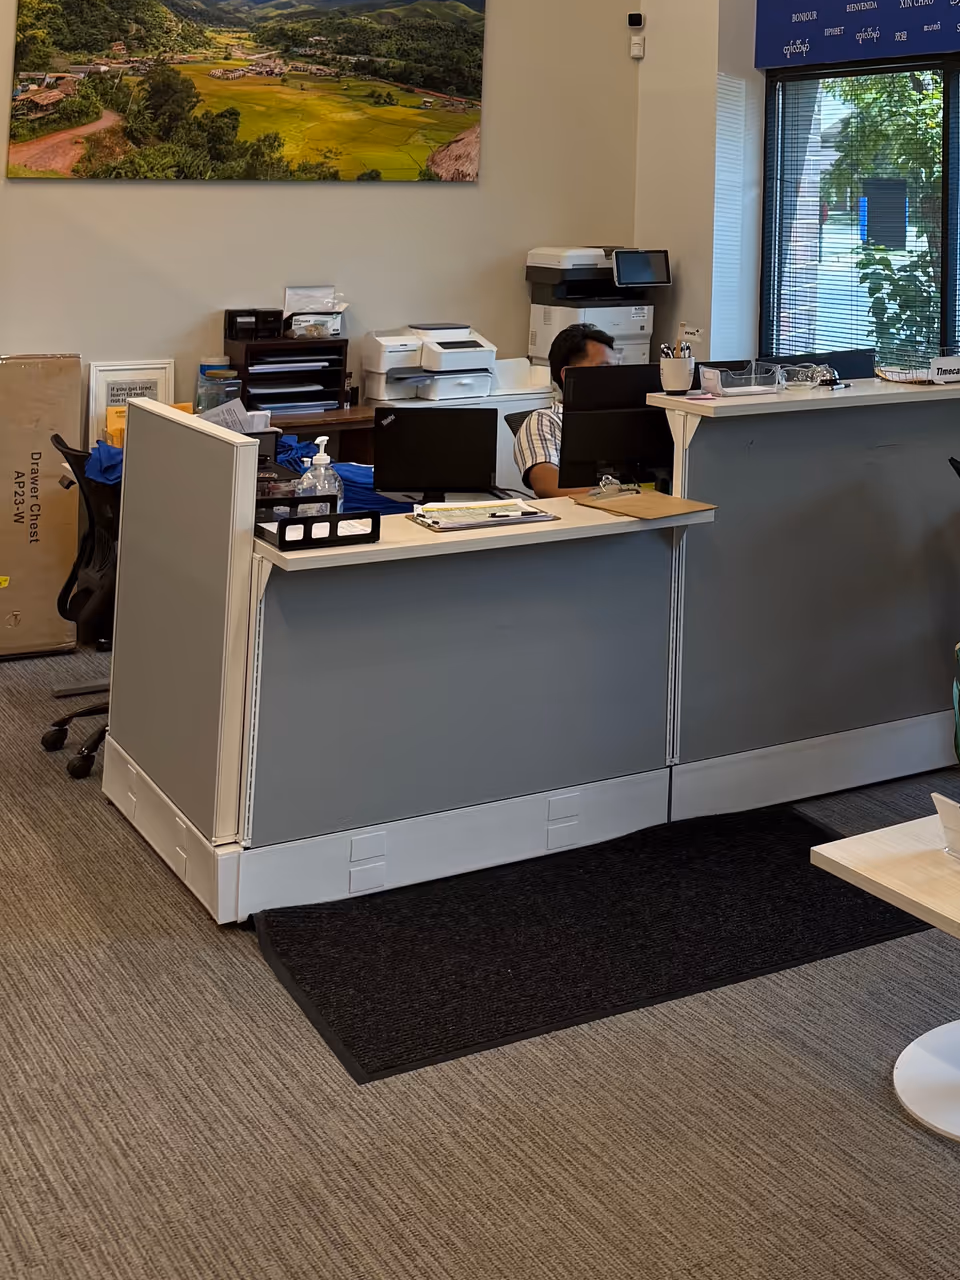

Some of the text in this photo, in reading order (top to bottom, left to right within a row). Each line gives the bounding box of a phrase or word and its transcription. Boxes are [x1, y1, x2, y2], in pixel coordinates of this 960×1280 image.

[846, 1, 878, 12] BIENVENIDA
[791, 10, 818, 22] BONJOUR
[824, 26, 845, 37] ПРИВЕТ
[13, 470, 26, 524] AP23-W
[29, 451, 42, 544] Drawer Chest
